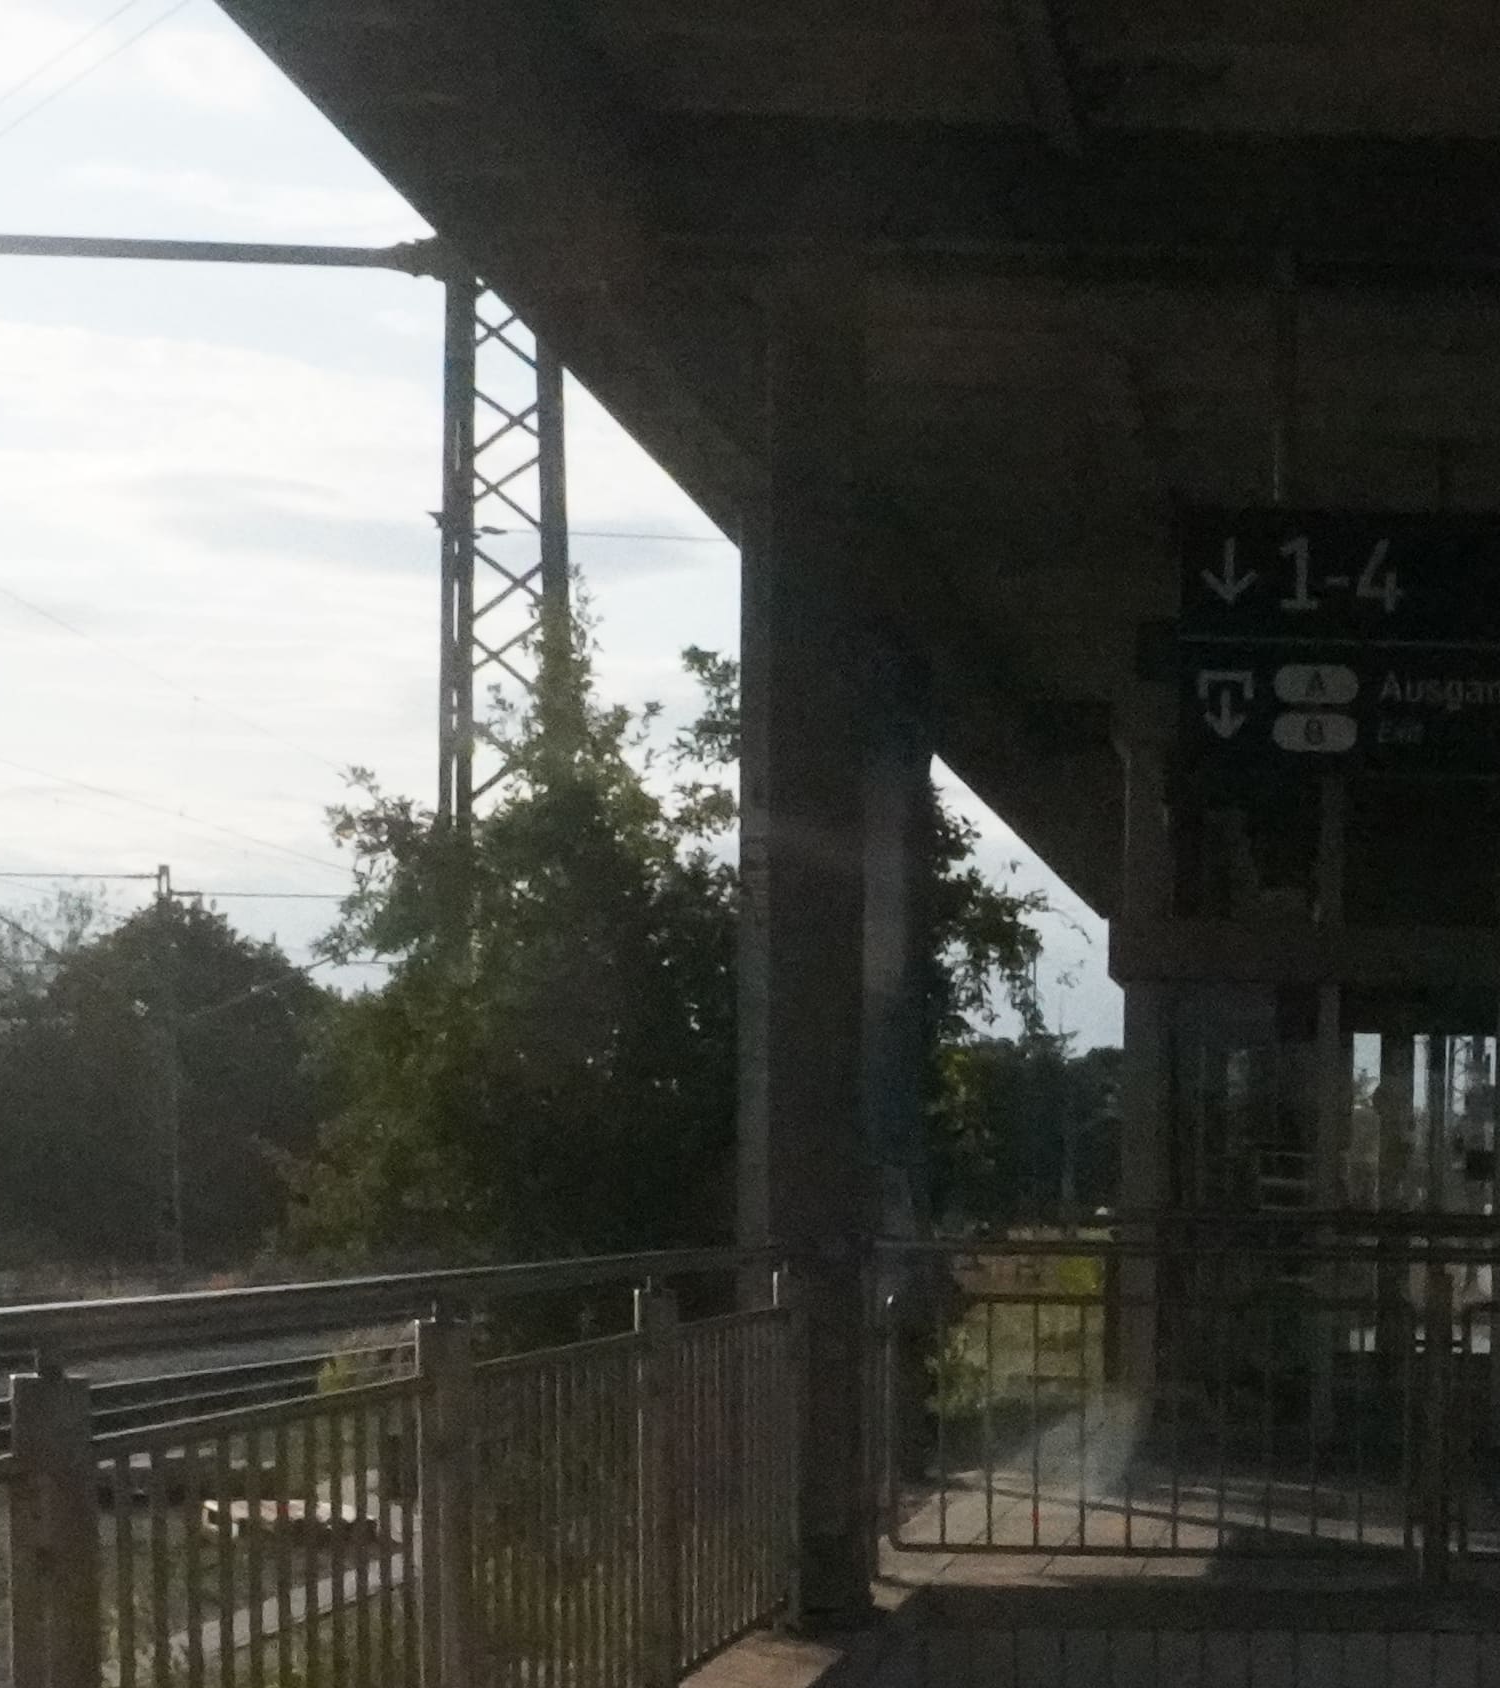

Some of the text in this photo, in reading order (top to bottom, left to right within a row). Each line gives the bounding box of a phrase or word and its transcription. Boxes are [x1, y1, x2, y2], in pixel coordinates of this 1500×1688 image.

[1278, 536, 1403, 612] 1-4
[1306, 672, 1327, 698] A
[1305, 720, 1326, 745] B
[1376, 720, 1424, 744] Exit
